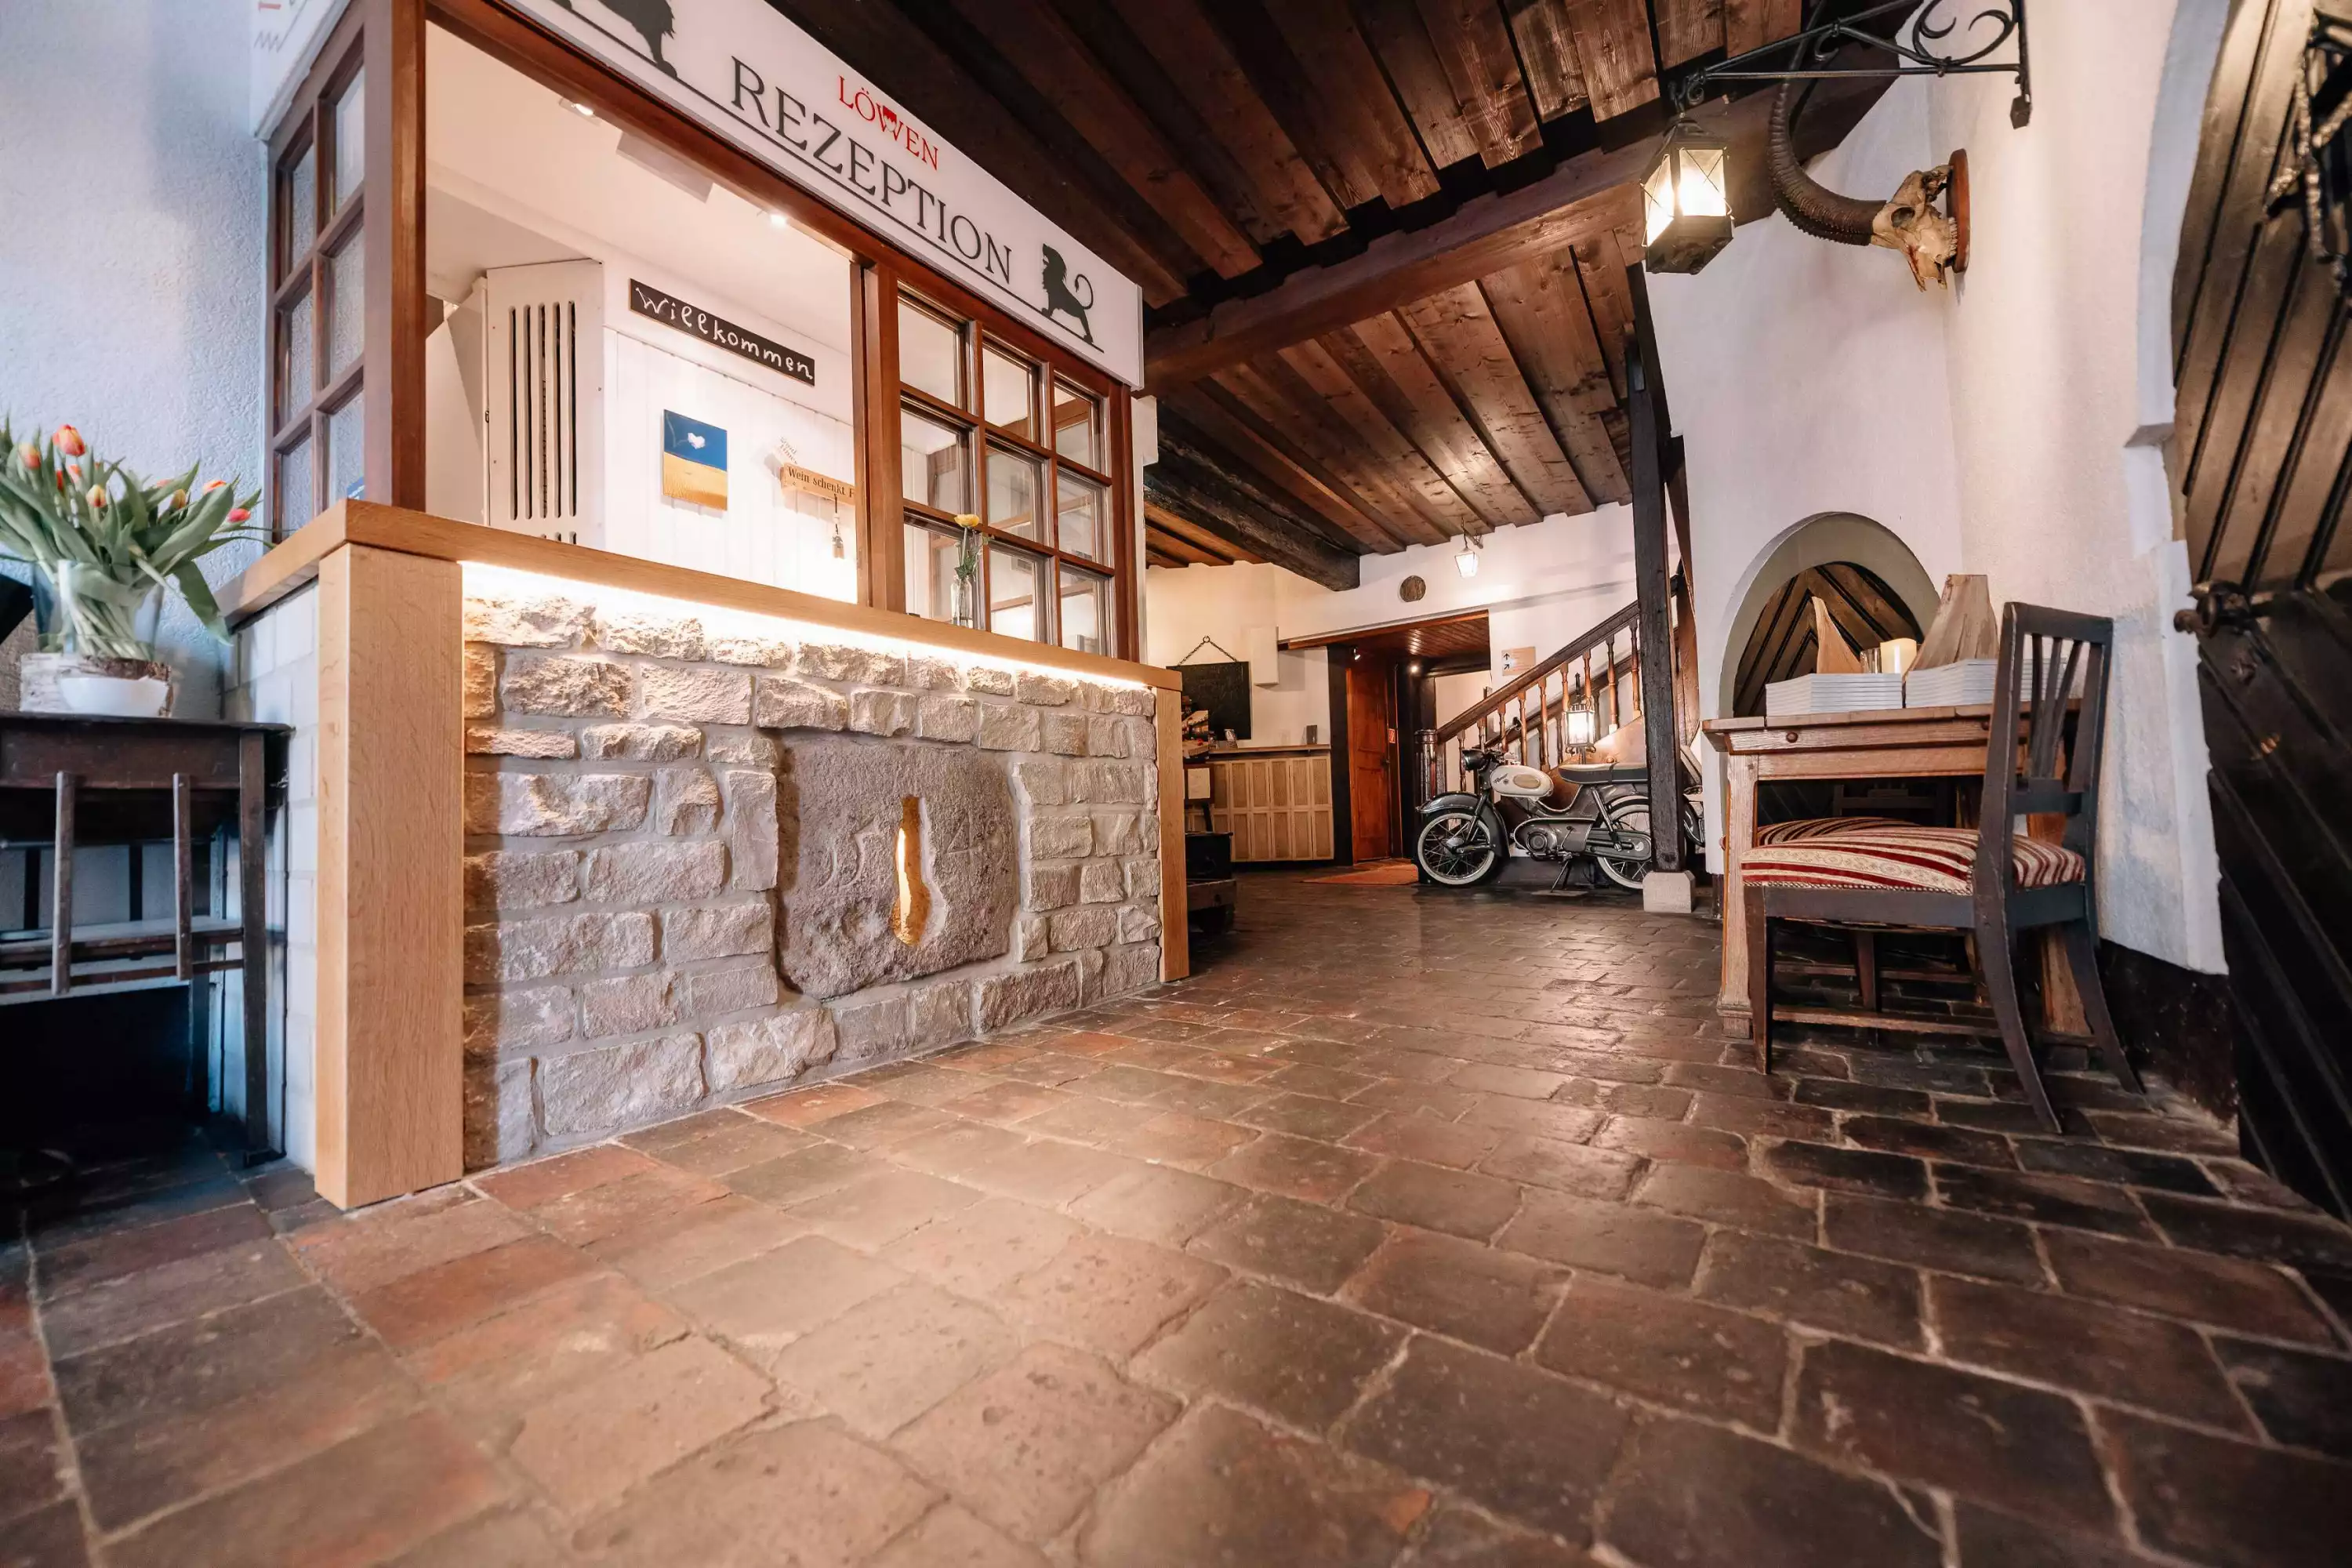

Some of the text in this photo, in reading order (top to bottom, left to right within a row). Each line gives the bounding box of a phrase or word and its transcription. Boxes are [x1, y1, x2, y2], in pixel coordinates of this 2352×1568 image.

[838, 75, 938, 171] LÖWEN
[731, 56, 1012, 285] REZEPTION
[635, 287, 813, 379] Willkommen
[787, 466, 810, 483] Wein
[813, 477, 846, 495] schenkt
